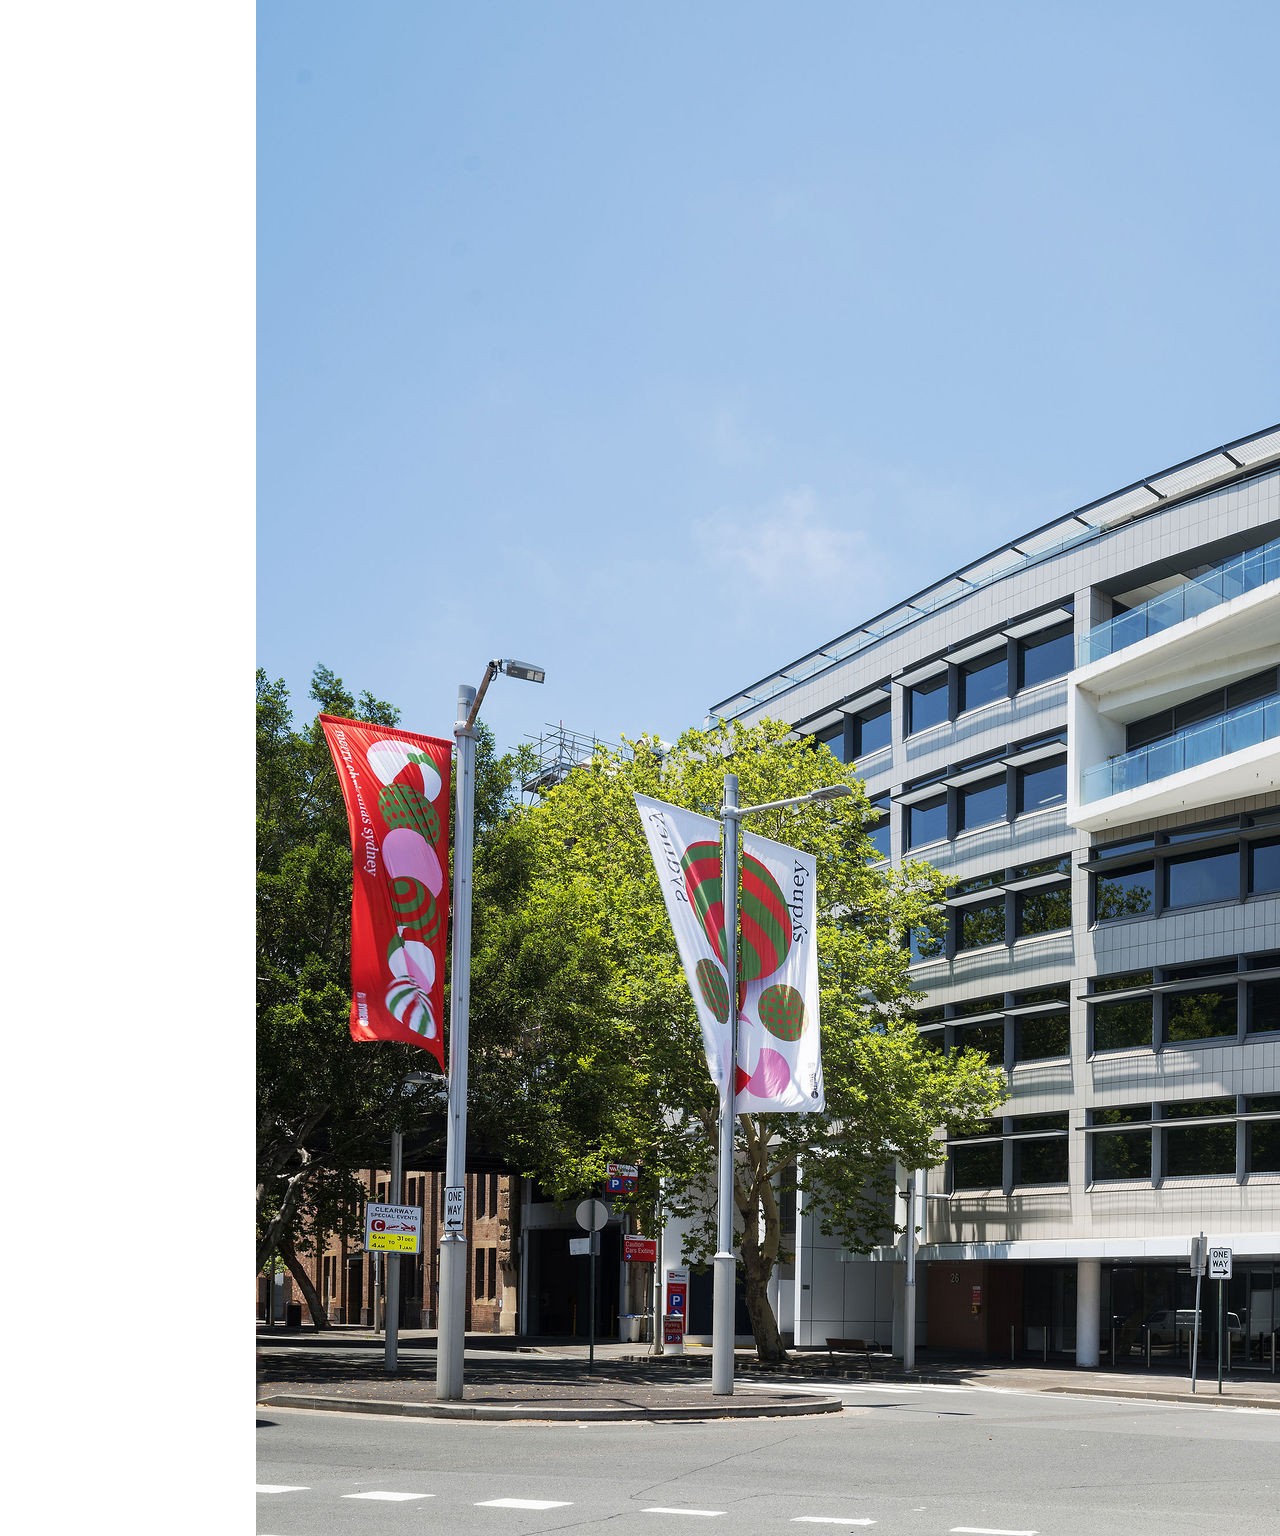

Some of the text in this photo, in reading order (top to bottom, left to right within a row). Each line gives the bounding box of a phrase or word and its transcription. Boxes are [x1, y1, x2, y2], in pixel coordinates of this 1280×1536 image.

[335, 730, 352, 766] merry
[361, 827, 380, 877] sydney
[788, 859, 810, 944] sydney
[612, 1180, 619, 1188] P
[448, 1191, 462, 1202] ONE
[375, 1206, 414, 1214] CLEARWAY
[447, 1204, 462, 1215] WAY
[638, 1247, 655, 1256] Exiting
[673, 1296, 680, 1305] P
